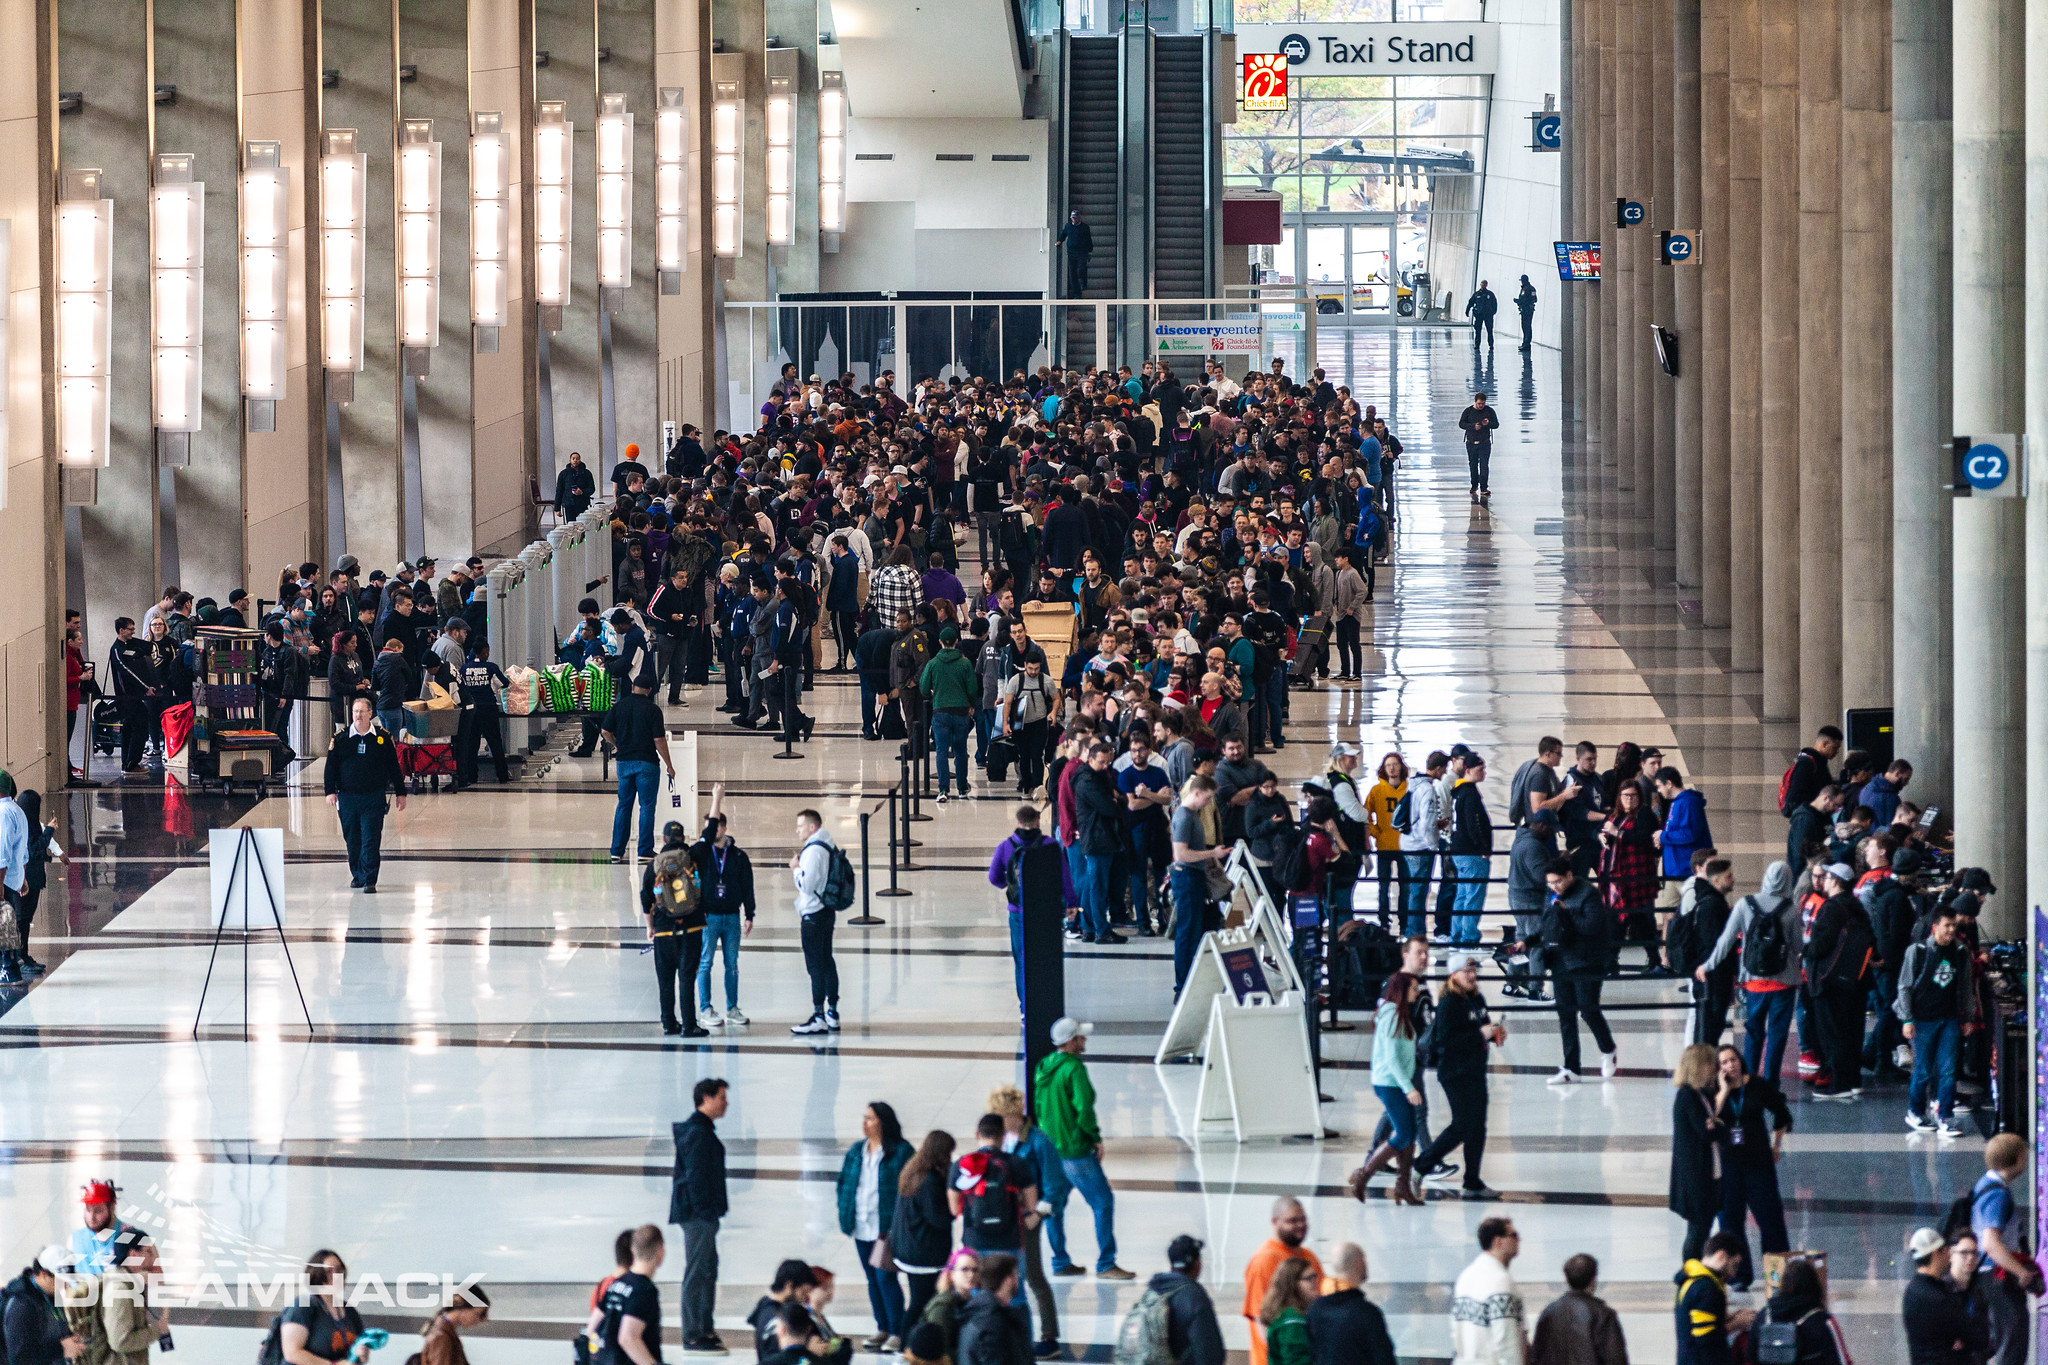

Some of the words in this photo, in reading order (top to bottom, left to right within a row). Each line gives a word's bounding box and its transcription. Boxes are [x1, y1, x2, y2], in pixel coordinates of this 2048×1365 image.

[1317, 36, 1374, 63] Taxi
[1387, 35, 1475, 63] Stand
[1245, 99, 1285, 108] Chick-fil-A
[1624, 207, 1642, 219] C3
[1668, 241, 1689, 255] C2
[1968, 455, 2003, 479] C2
[465, 667, 488, 676] argus
